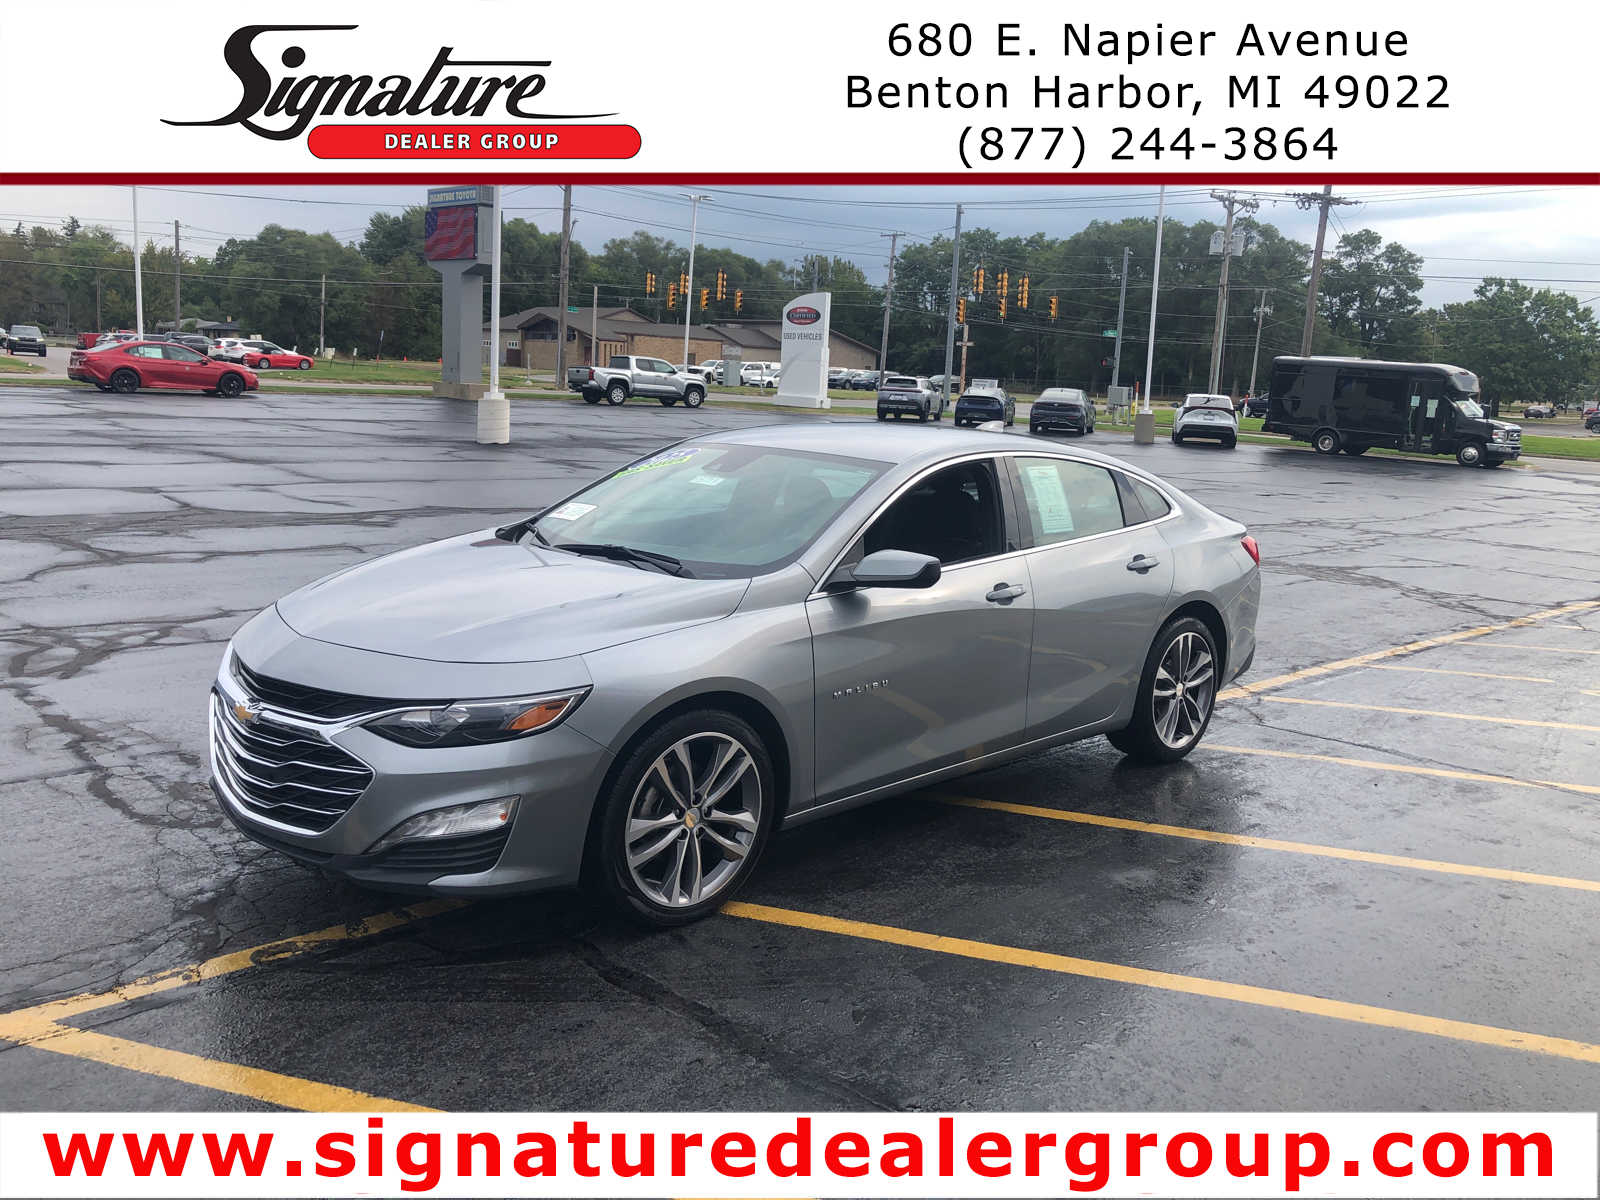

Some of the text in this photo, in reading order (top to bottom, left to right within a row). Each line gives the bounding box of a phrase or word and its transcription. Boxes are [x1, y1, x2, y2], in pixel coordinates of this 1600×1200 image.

[783, 332, 822, 341] USED VEHICLES
[832, 679, 889, 700] MALIBU
